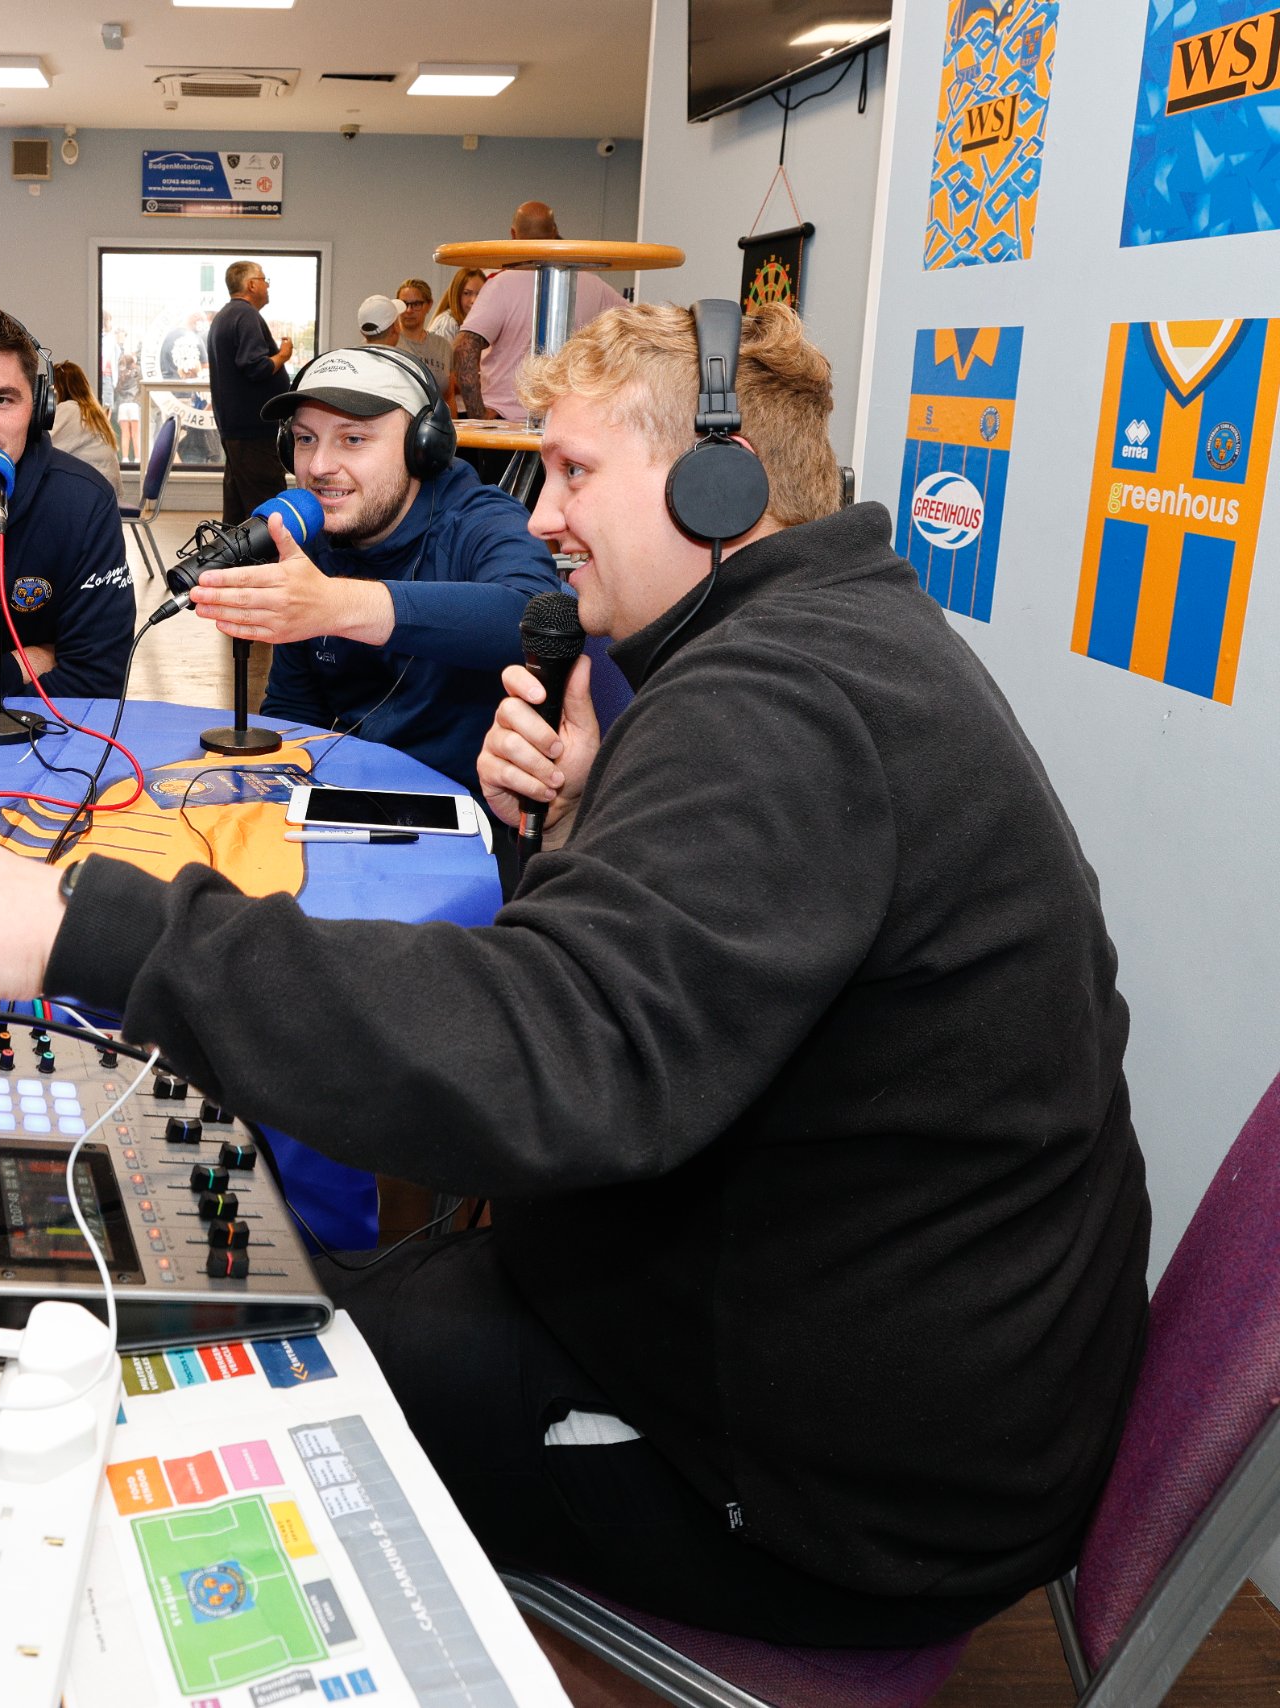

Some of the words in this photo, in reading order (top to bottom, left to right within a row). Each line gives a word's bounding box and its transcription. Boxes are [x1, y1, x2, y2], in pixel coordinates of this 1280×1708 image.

[1177, 11, 1280, 91] WSJ
[967, 93, 1019, 141] WSJ
[913, 496, 982, 530] GREENHOUS
[1108, 481, 1240, 526] greenhous
[131, 1356, 150, 1391] MILITARY
[141, 1356, 159, 1390] VEHICLES
[125, 1475, 141, 1501] FOOD
[135, 1468, 154, 1505] VENDOR
[379, 1538, 417, 1597] PARKING
[159, 1575, 183, 1627] STADIUM
